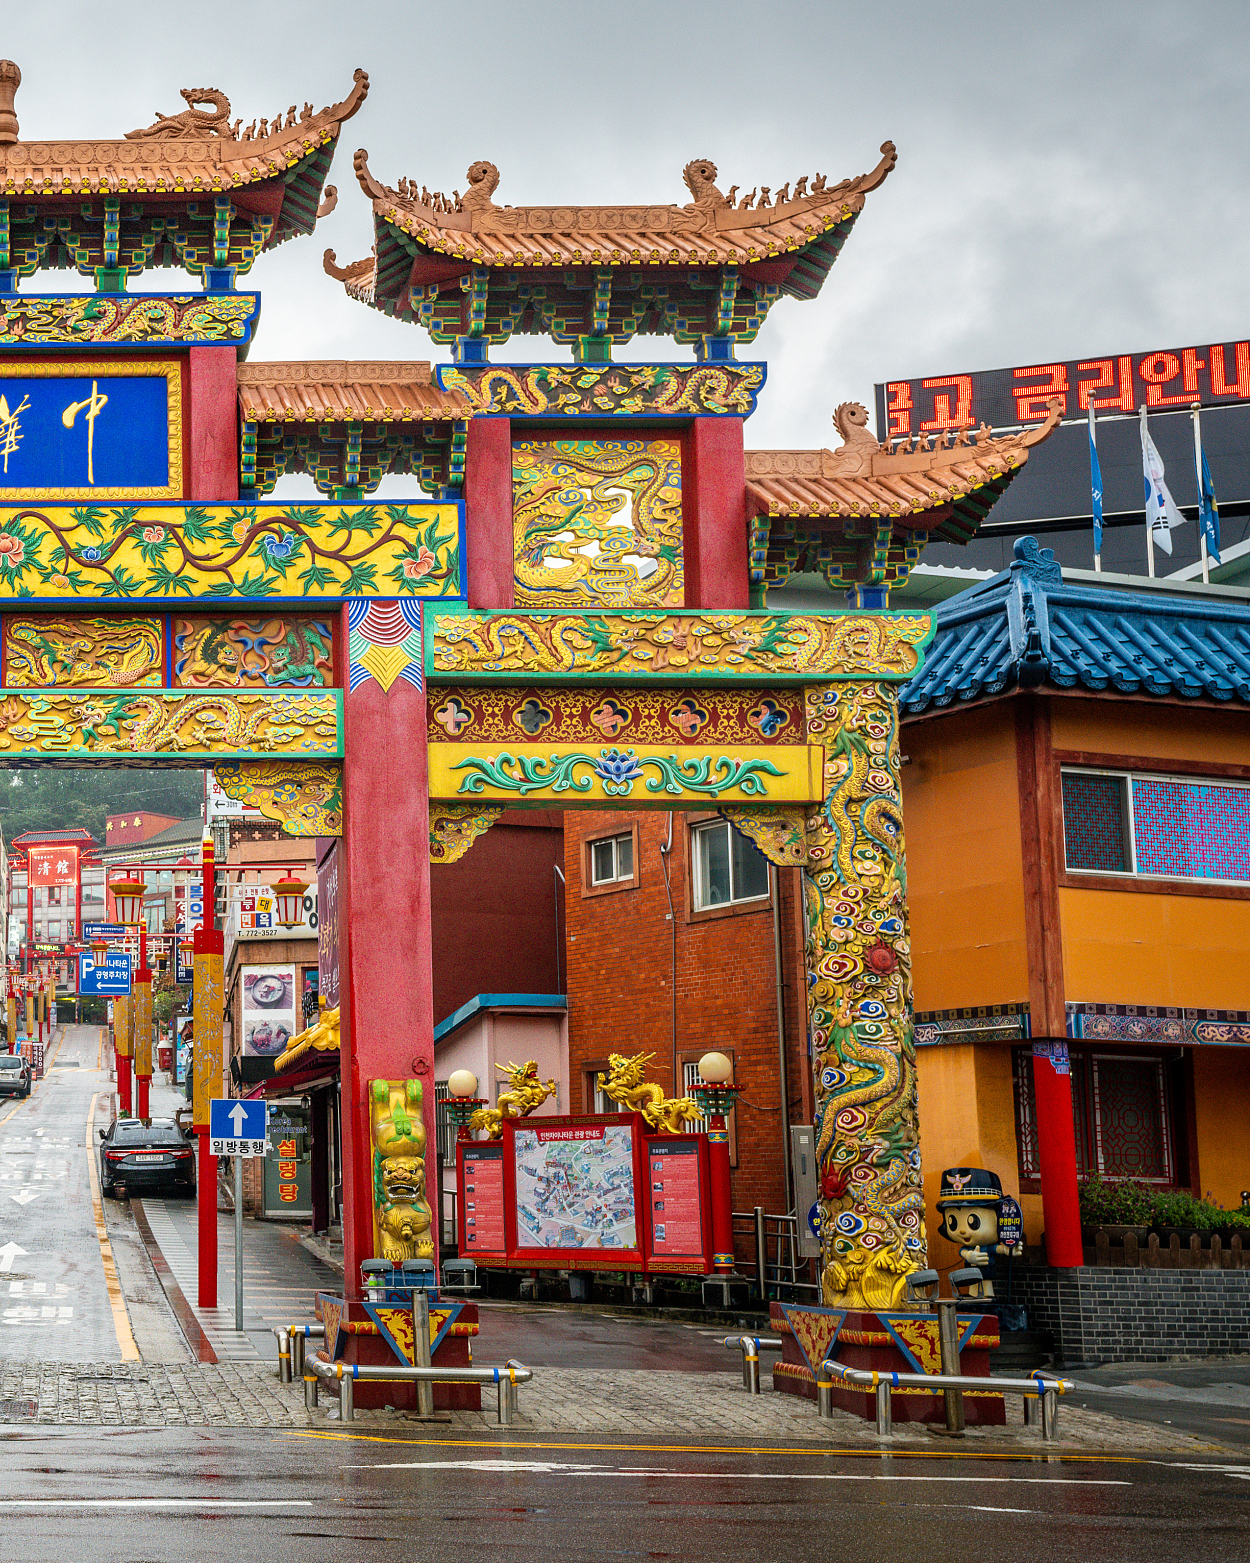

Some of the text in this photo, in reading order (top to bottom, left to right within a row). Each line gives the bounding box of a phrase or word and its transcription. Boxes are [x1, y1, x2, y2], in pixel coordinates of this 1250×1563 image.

[95, 970, 129, 980] 공영주차장
[270, 1117, 292, 1125] Korea
[268, 1125, 308, 1134] restaurant
[213, 1140, 264, 1154] 일방통행
[277, 1139, 299, 1203] 설렁탕
